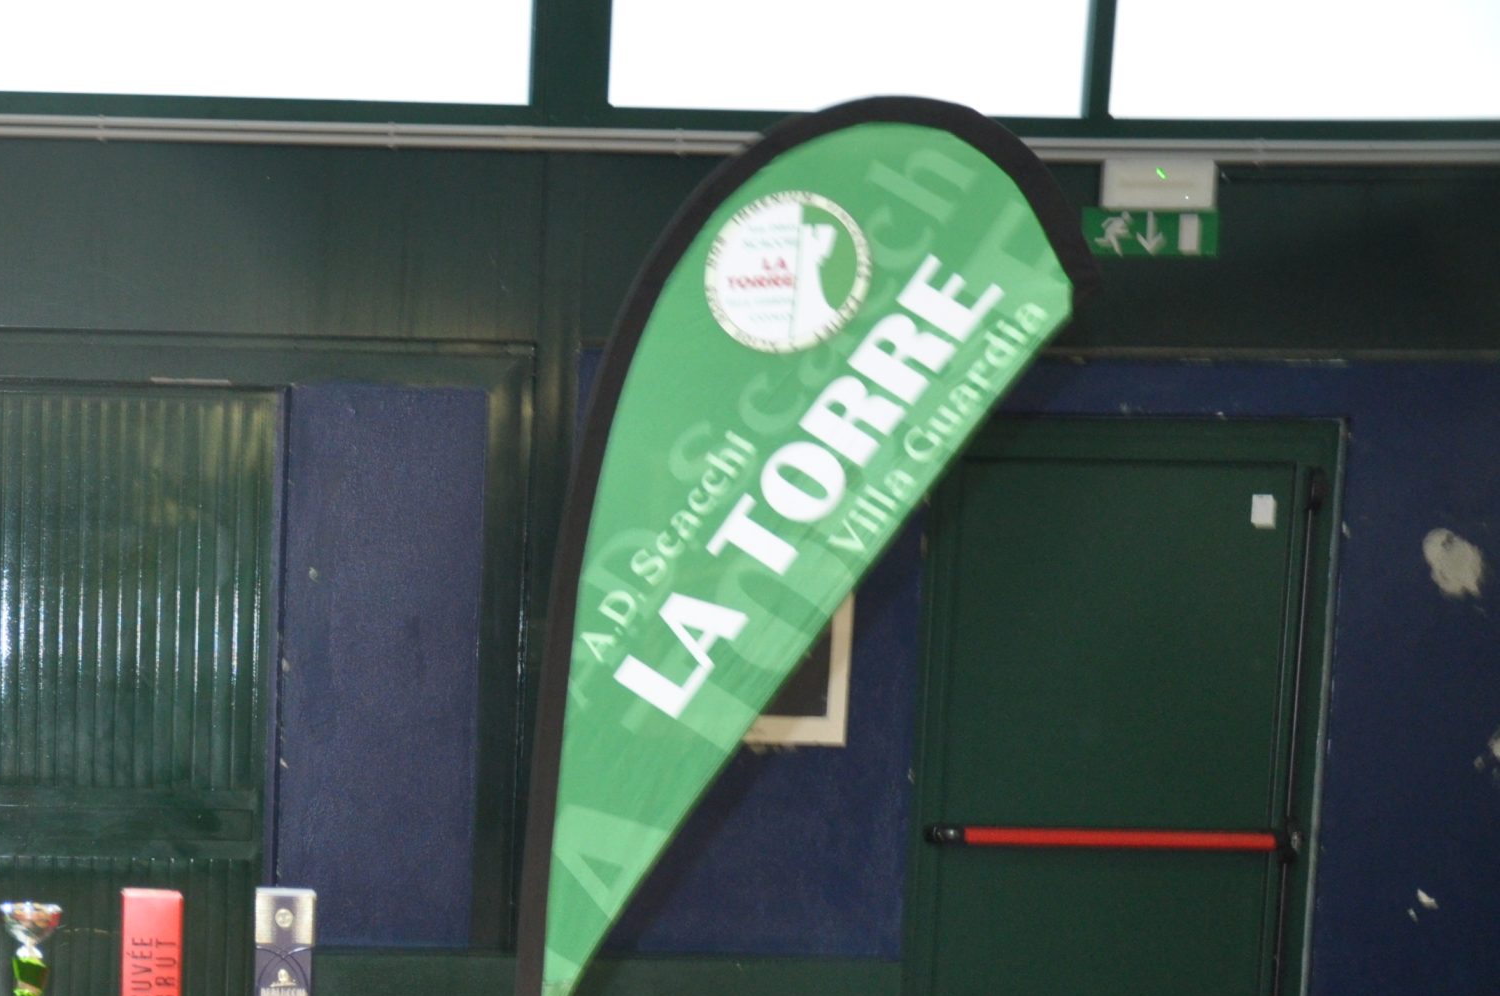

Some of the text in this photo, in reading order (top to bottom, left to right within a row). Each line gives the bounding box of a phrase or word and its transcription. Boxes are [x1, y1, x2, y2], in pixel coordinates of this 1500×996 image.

[613, 253, 1005, 719] LA TORRE
[827, 465, 917, 555] Villa
[903, 302, 1049, 463] Guardia
